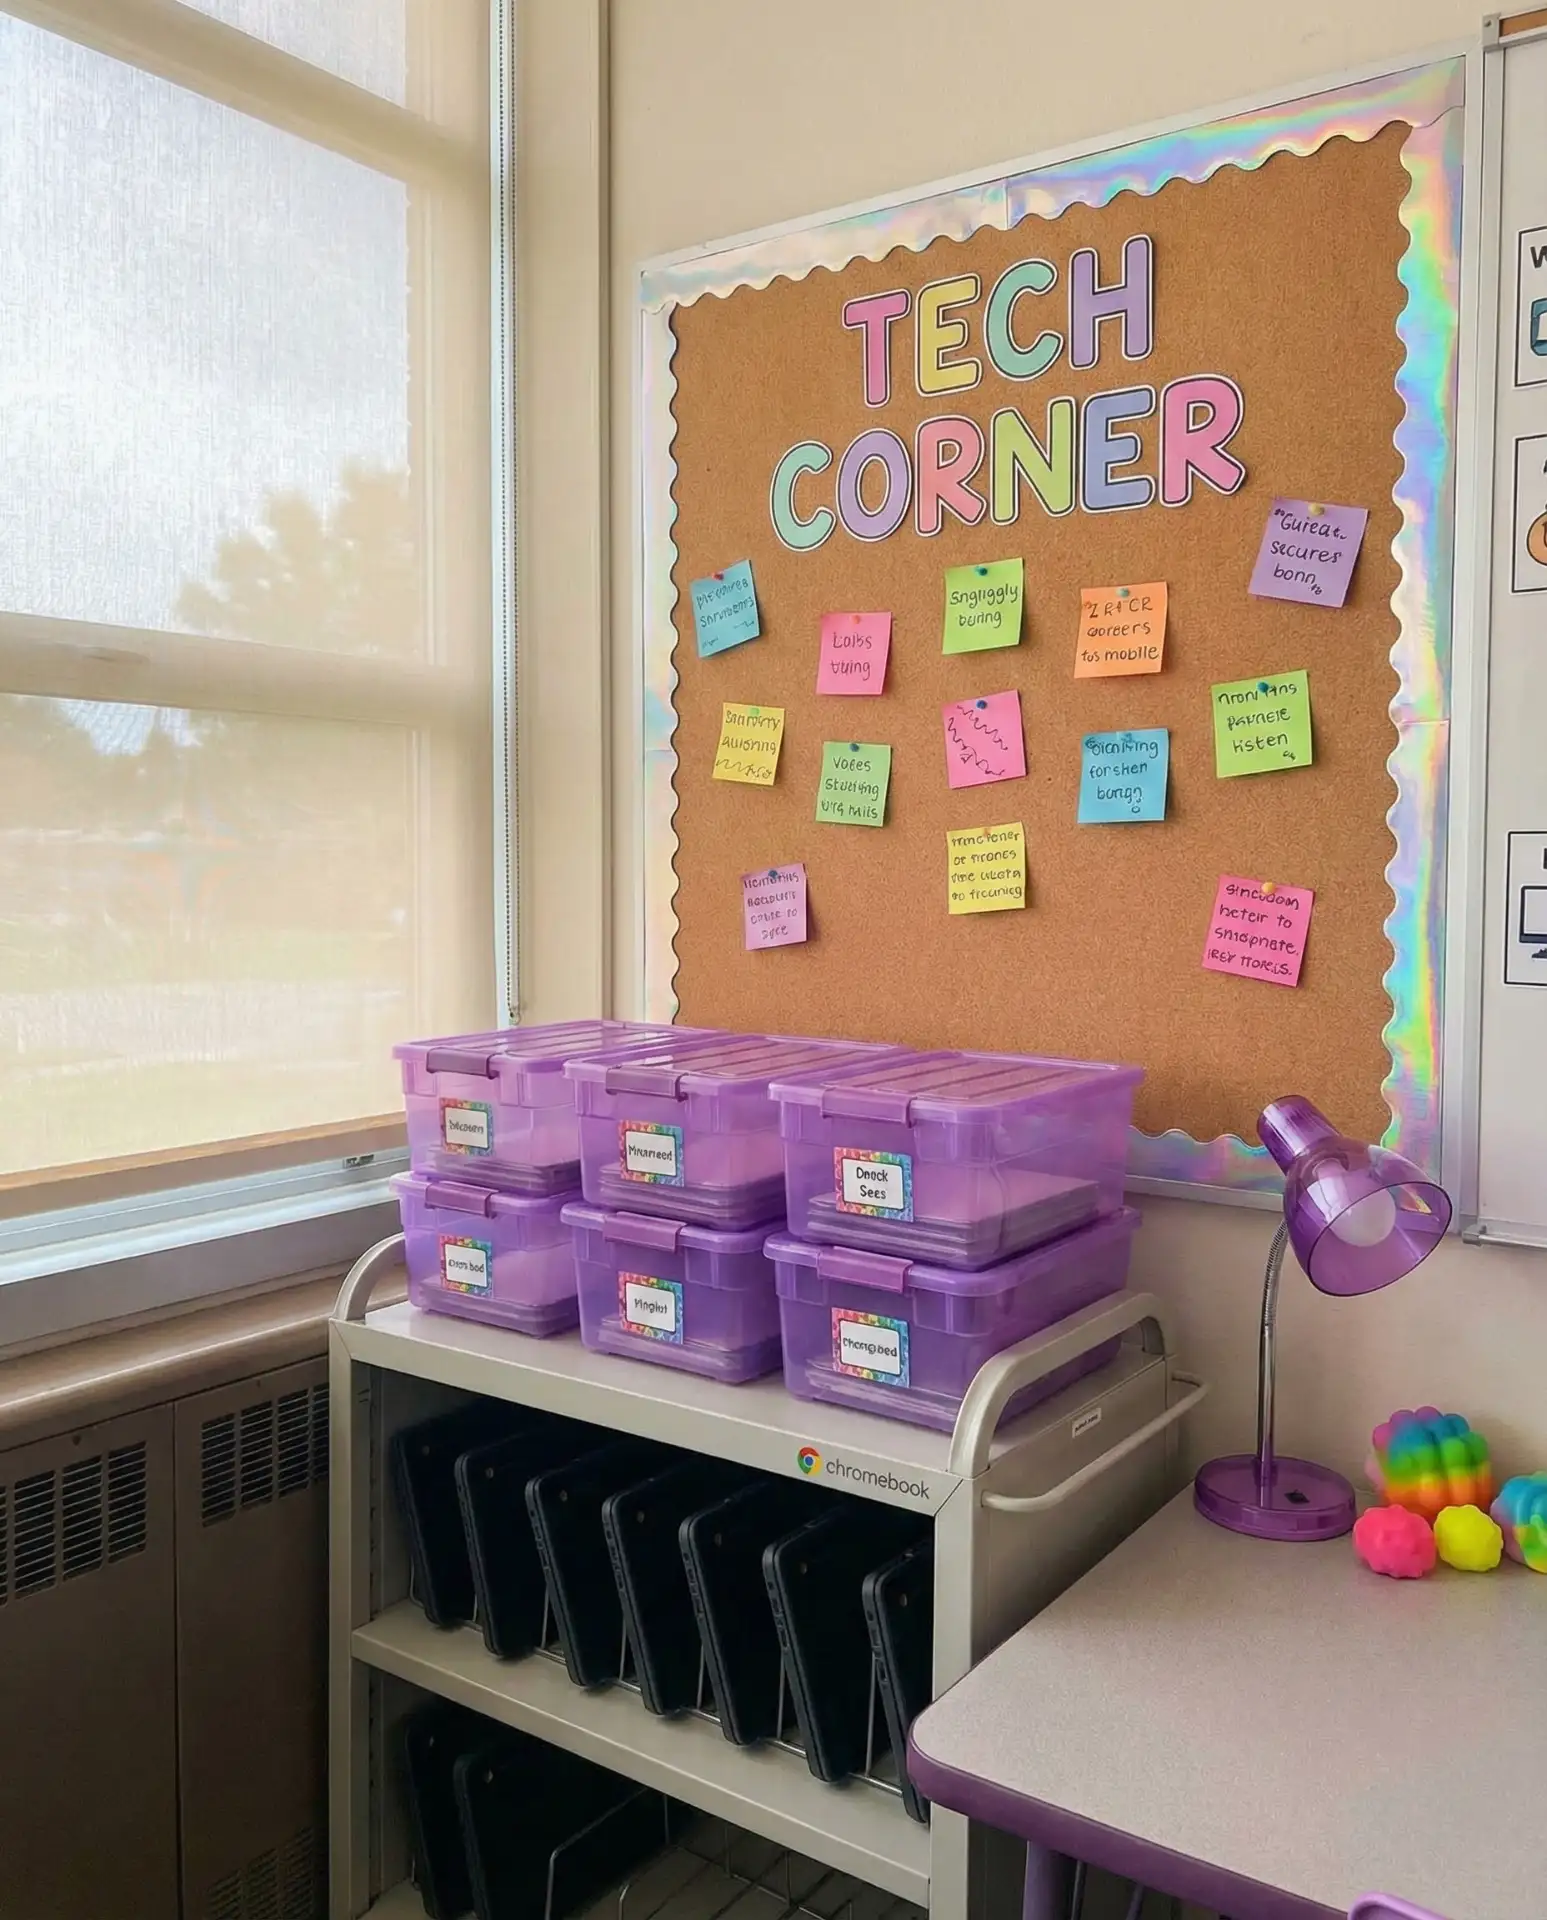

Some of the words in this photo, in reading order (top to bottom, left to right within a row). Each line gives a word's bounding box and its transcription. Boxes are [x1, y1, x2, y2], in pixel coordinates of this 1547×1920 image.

[843, 234, 1155, 407] TECH
[770, 374, 1247, 552] CORNER
[1276, 913, 1293, 929] to
[826, 1459, 930, 1500] chromebook
